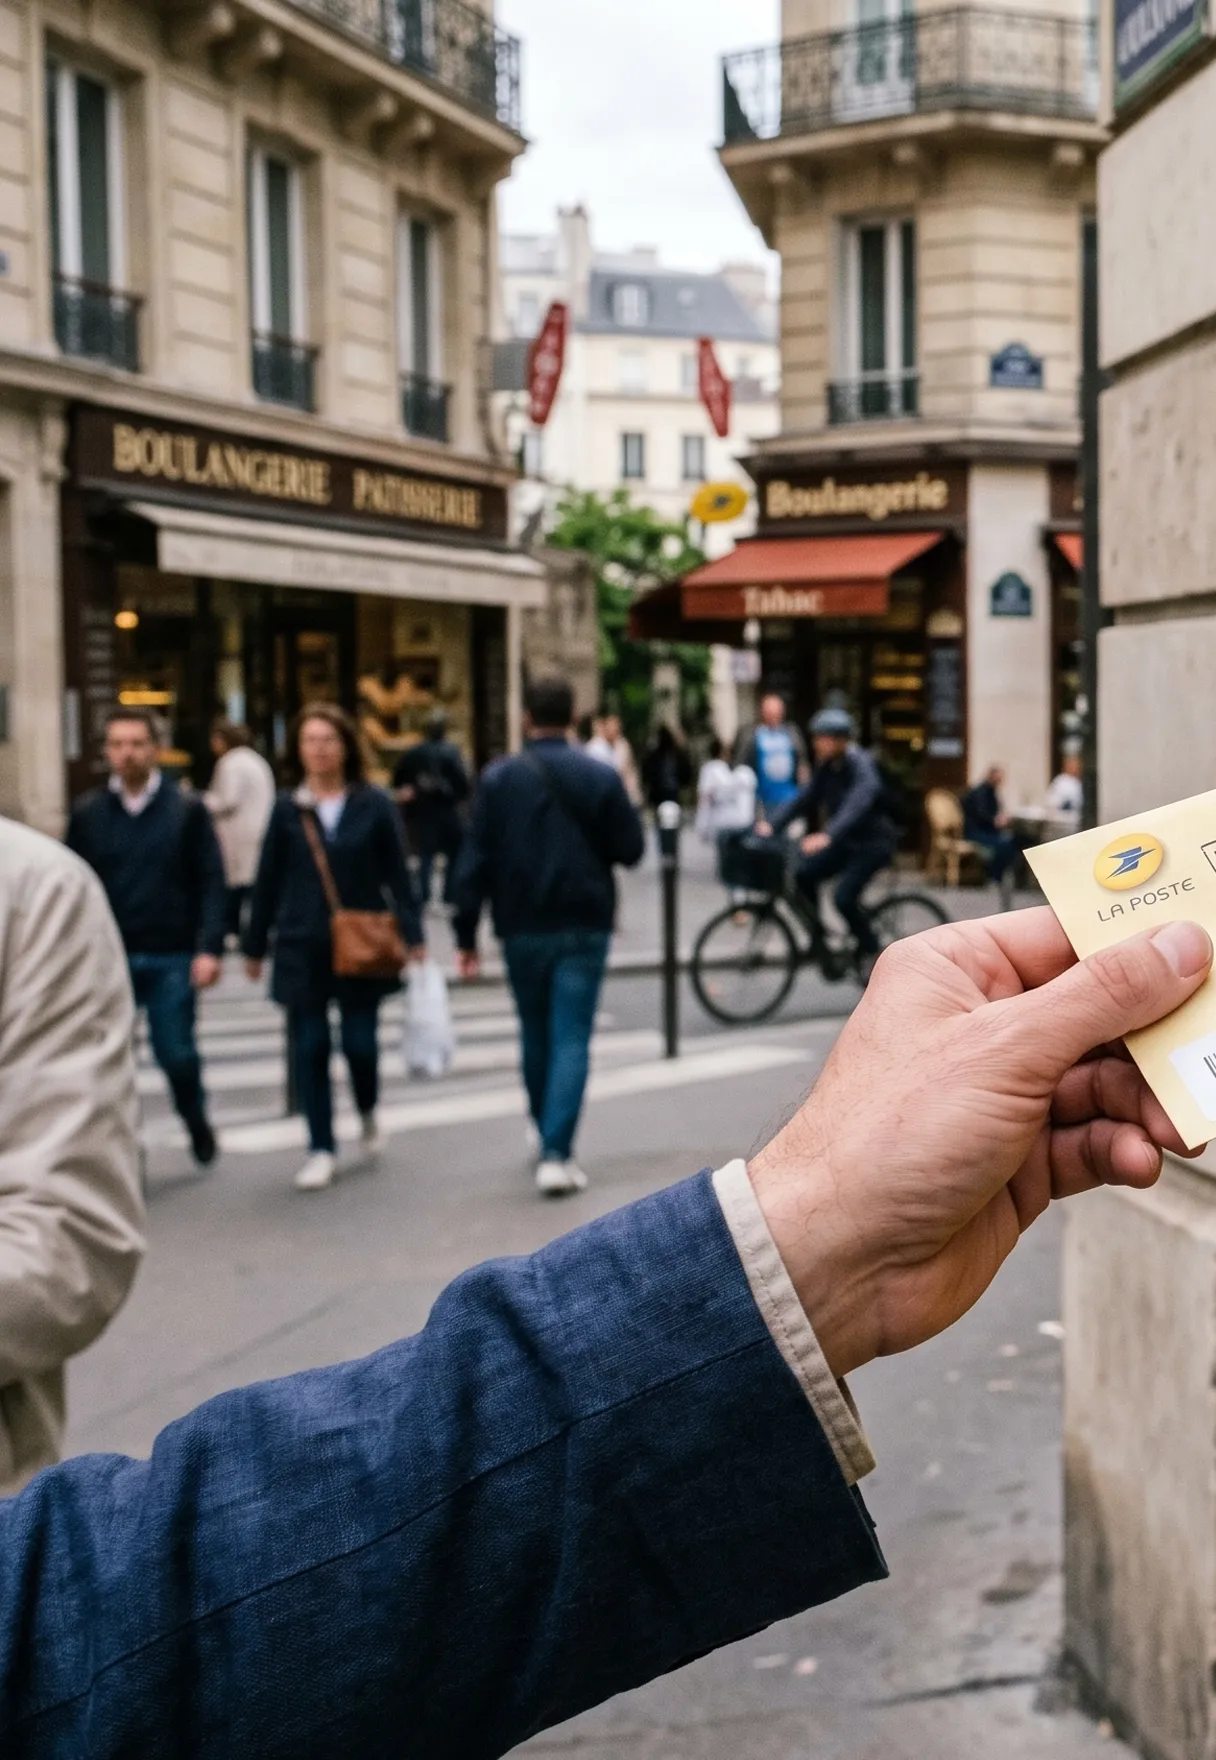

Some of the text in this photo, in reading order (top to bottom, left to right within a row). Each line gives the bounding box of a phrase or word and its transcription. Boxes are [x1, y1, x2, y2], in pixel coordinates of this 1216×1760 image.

[112, 423, 483, 530] BOULANGERIE PATISSERIE
[766, 471, 948, 521] Boulangerie
[1097, 877, 1196, 922] LA POSTE
